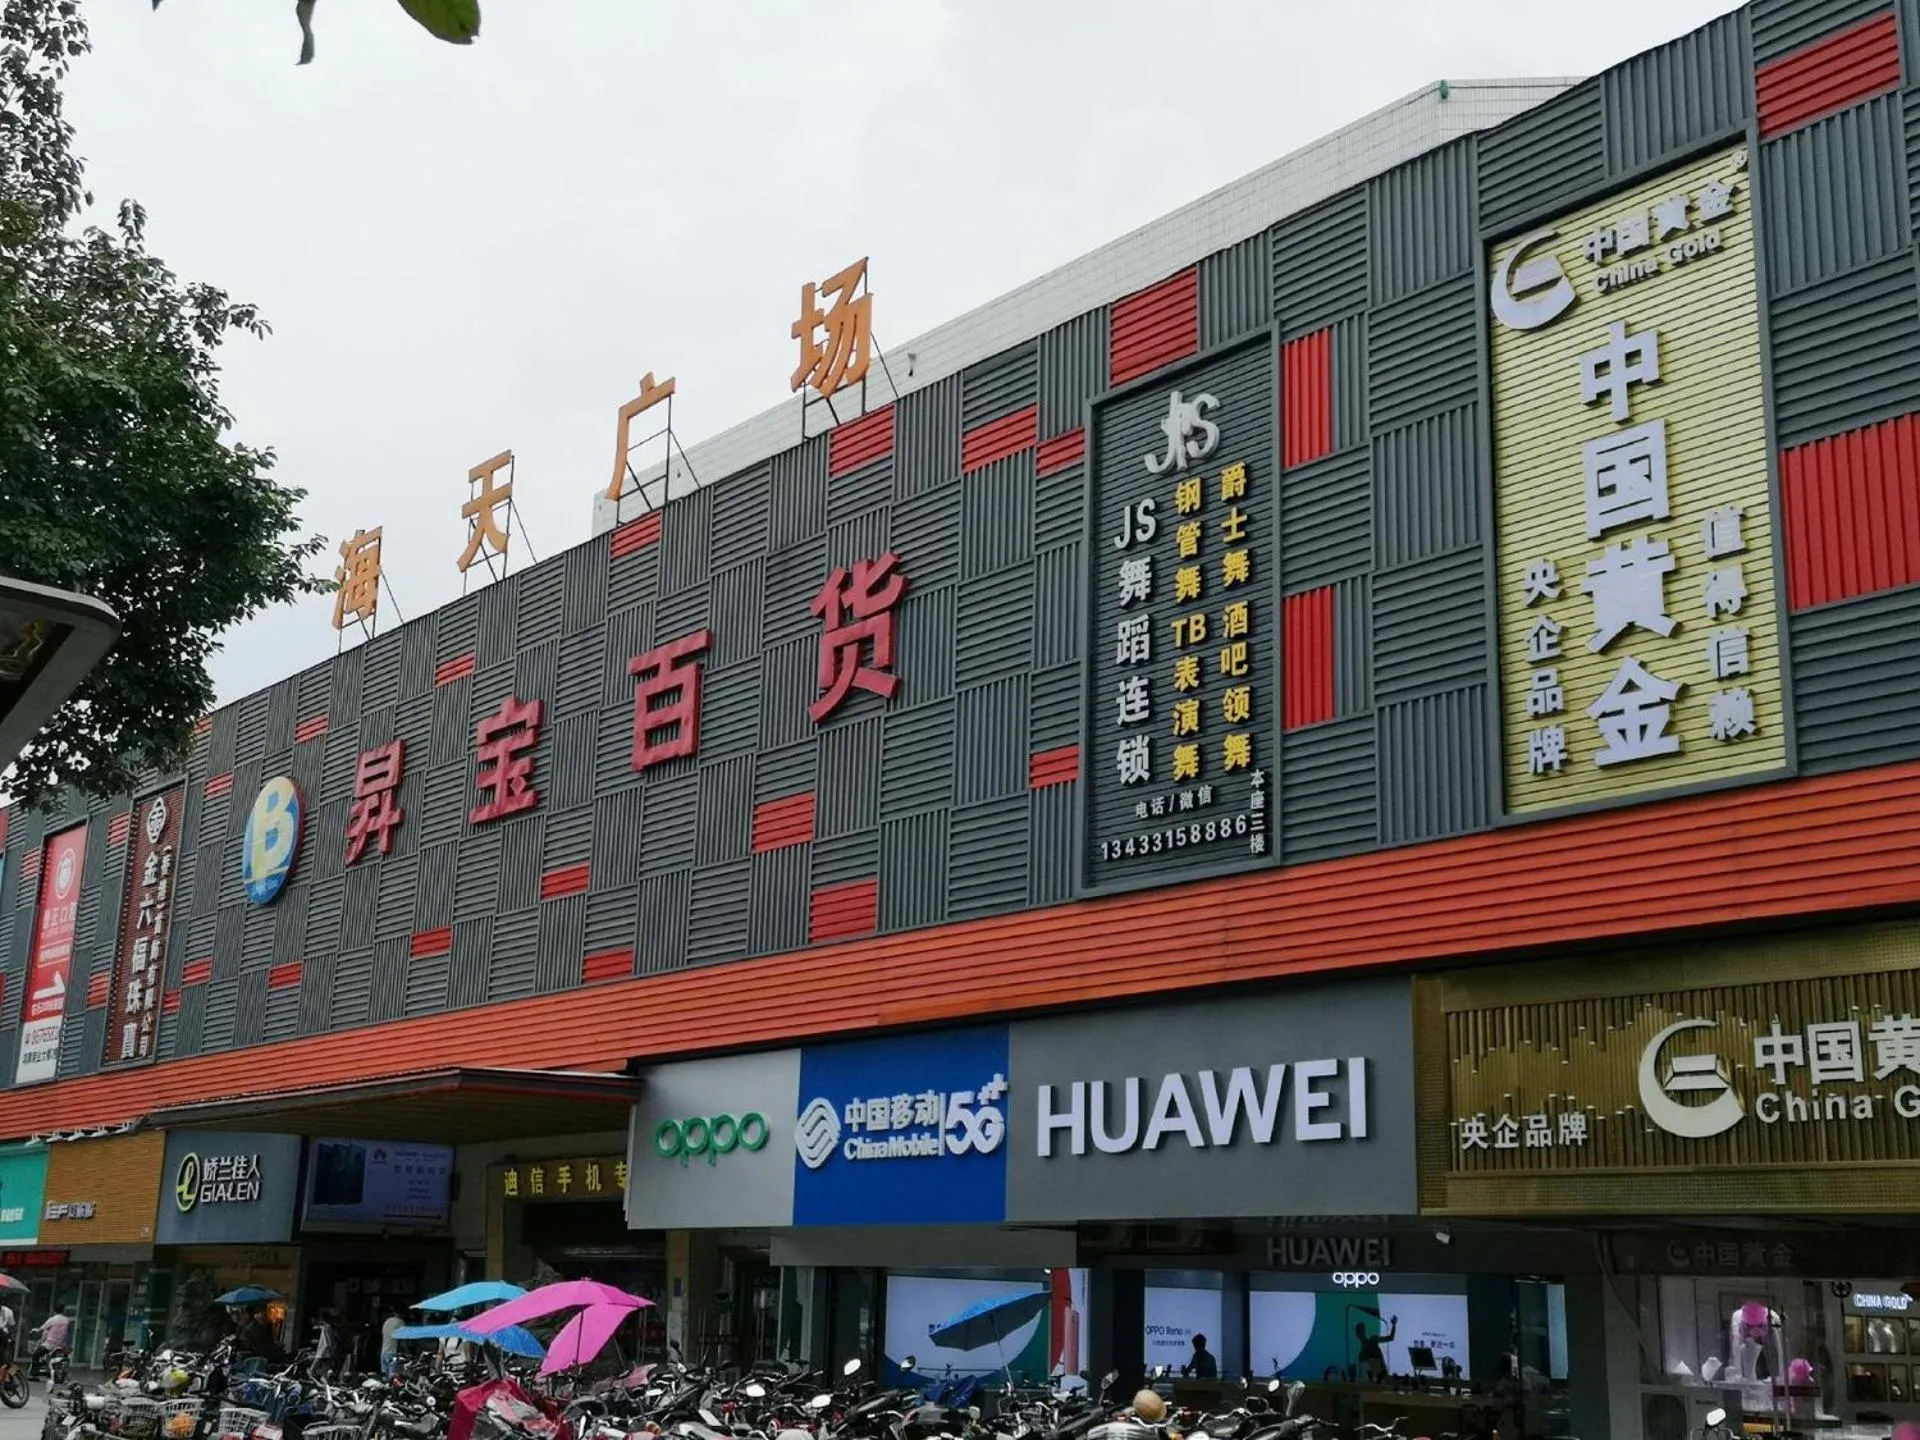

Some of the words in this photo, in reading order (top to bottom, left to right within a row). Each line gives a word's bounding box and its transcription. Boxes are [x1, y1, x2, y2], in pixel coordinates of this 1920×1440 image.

[1583, 178, 1738, 264] 中国黄金
[1593, 258, 1659, 294] China
[1666, 228, 1722, 266] Gold
[332, 257, 874, 630] 海天广场
[1580, 320, 1686, 766] 中国黄金
[1218, 459, 1252, 772] 爵士舞酒吧领舞
[1524, 556, 1569, 776] 央企品牌
[345, 550, 906, 866] 昇宝百货
[1101, 813, 1248, 861] 13433158886
[1250, 768, 1265, 855] 本座三楼
[844, 1088, 942, 1134] 中国移动
[1036, 1056, 1368, 1157] HUAWEI
[1461, 1110, 1588, 1151] 央企品牌
[1756, 1089, 1874, 1124] China
[200, 1181, 260, 1203] GIALEN
[202, 1154, 260, 1181] 娇兰佳人
[1266, 1238, 1391, 1267] HUAWEI
[1696, 1242, 1795, 1267] 中国黄金
